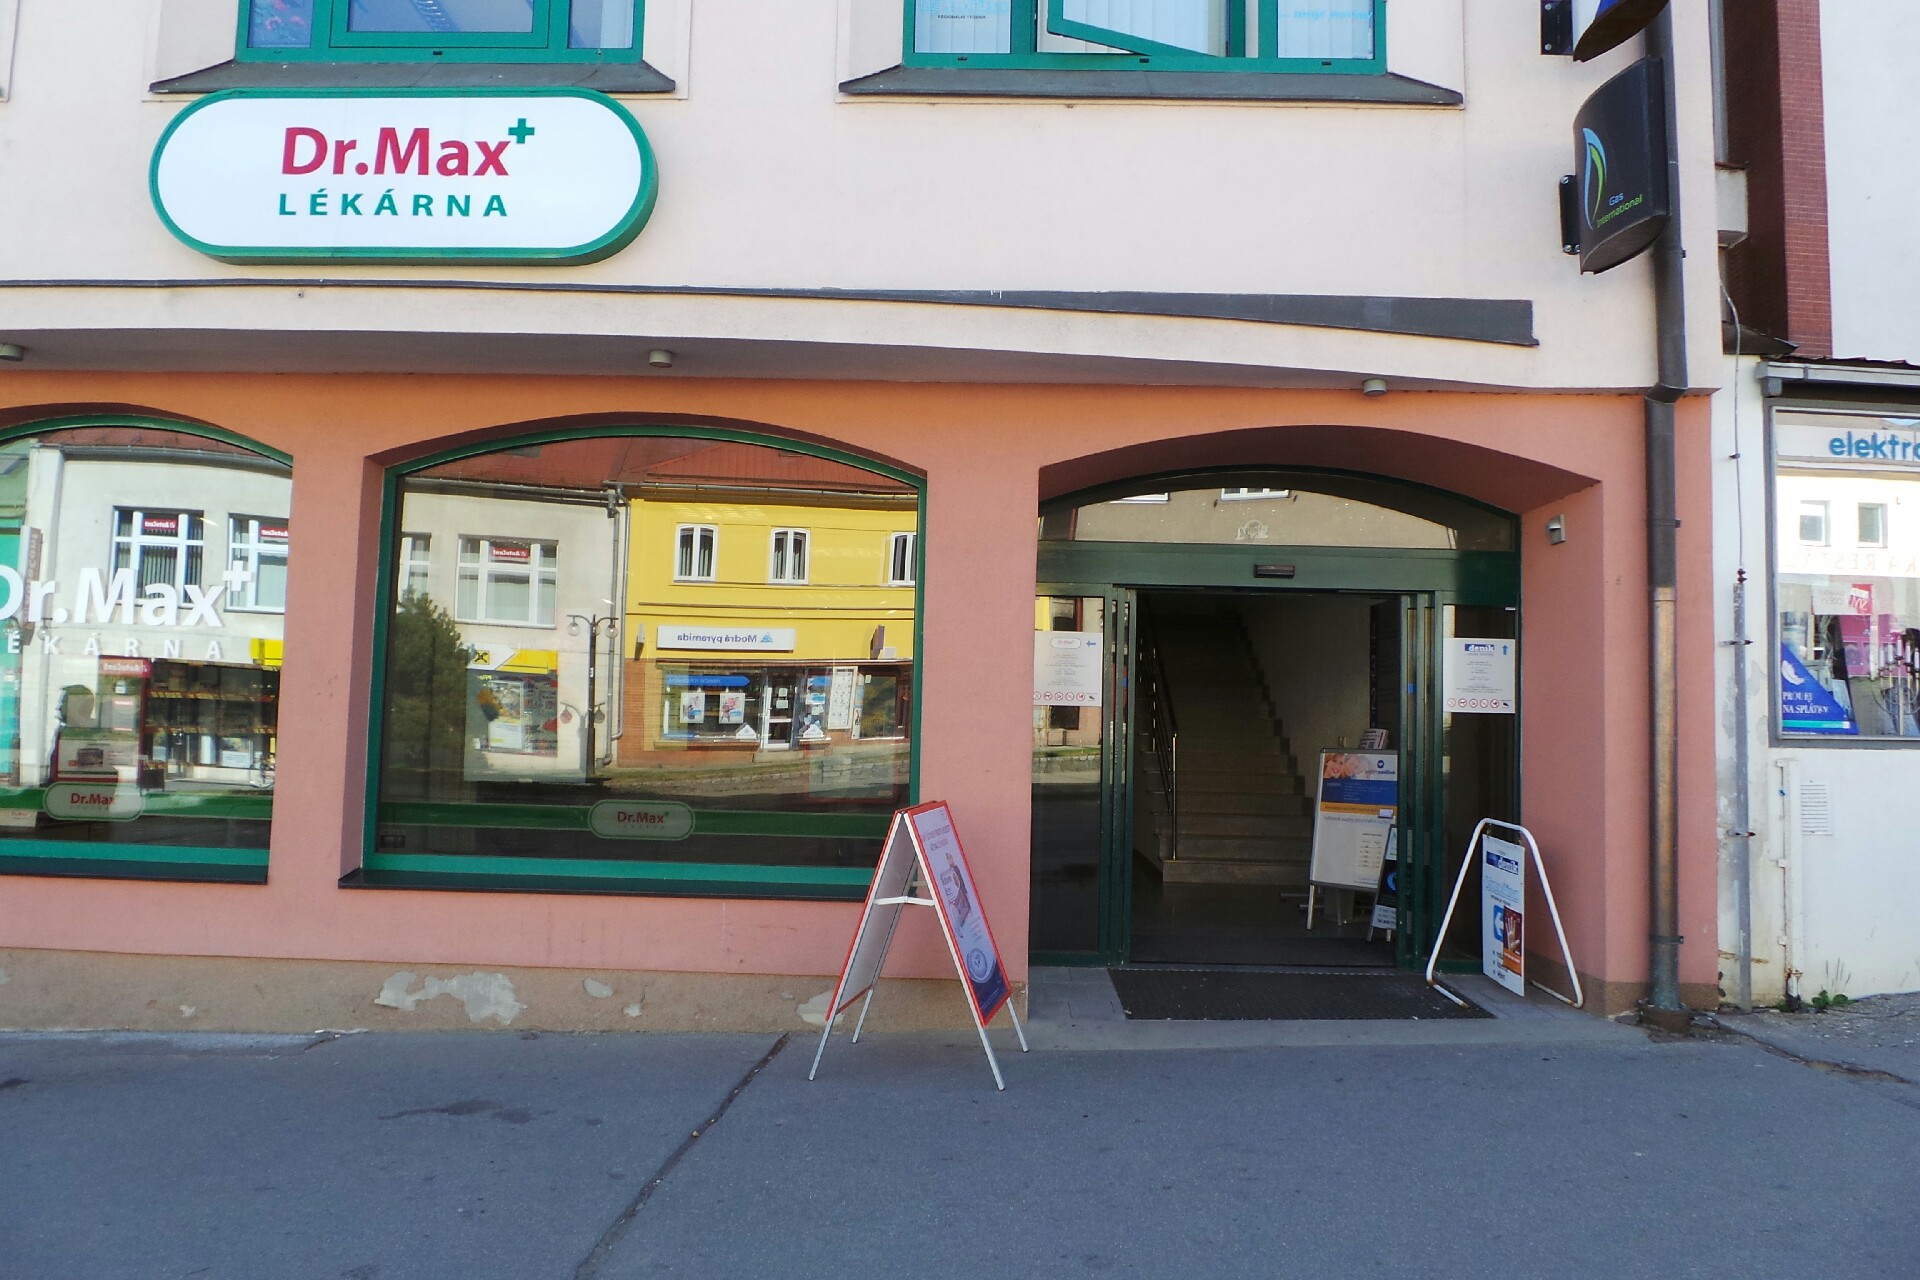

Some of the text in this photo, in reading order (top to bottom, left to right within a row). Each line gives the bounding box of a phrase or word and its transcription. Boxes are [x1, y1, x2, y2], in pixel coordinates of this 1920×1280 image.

[281, 127, 511, 177] Dr.Max
[279, 188, 508, 217] LÉKÁRNA
[1596, 194, 1643, 228] International
[1608, 192, 1624, 206] Gas
[617, 811, 664, 824] Dr.Max
